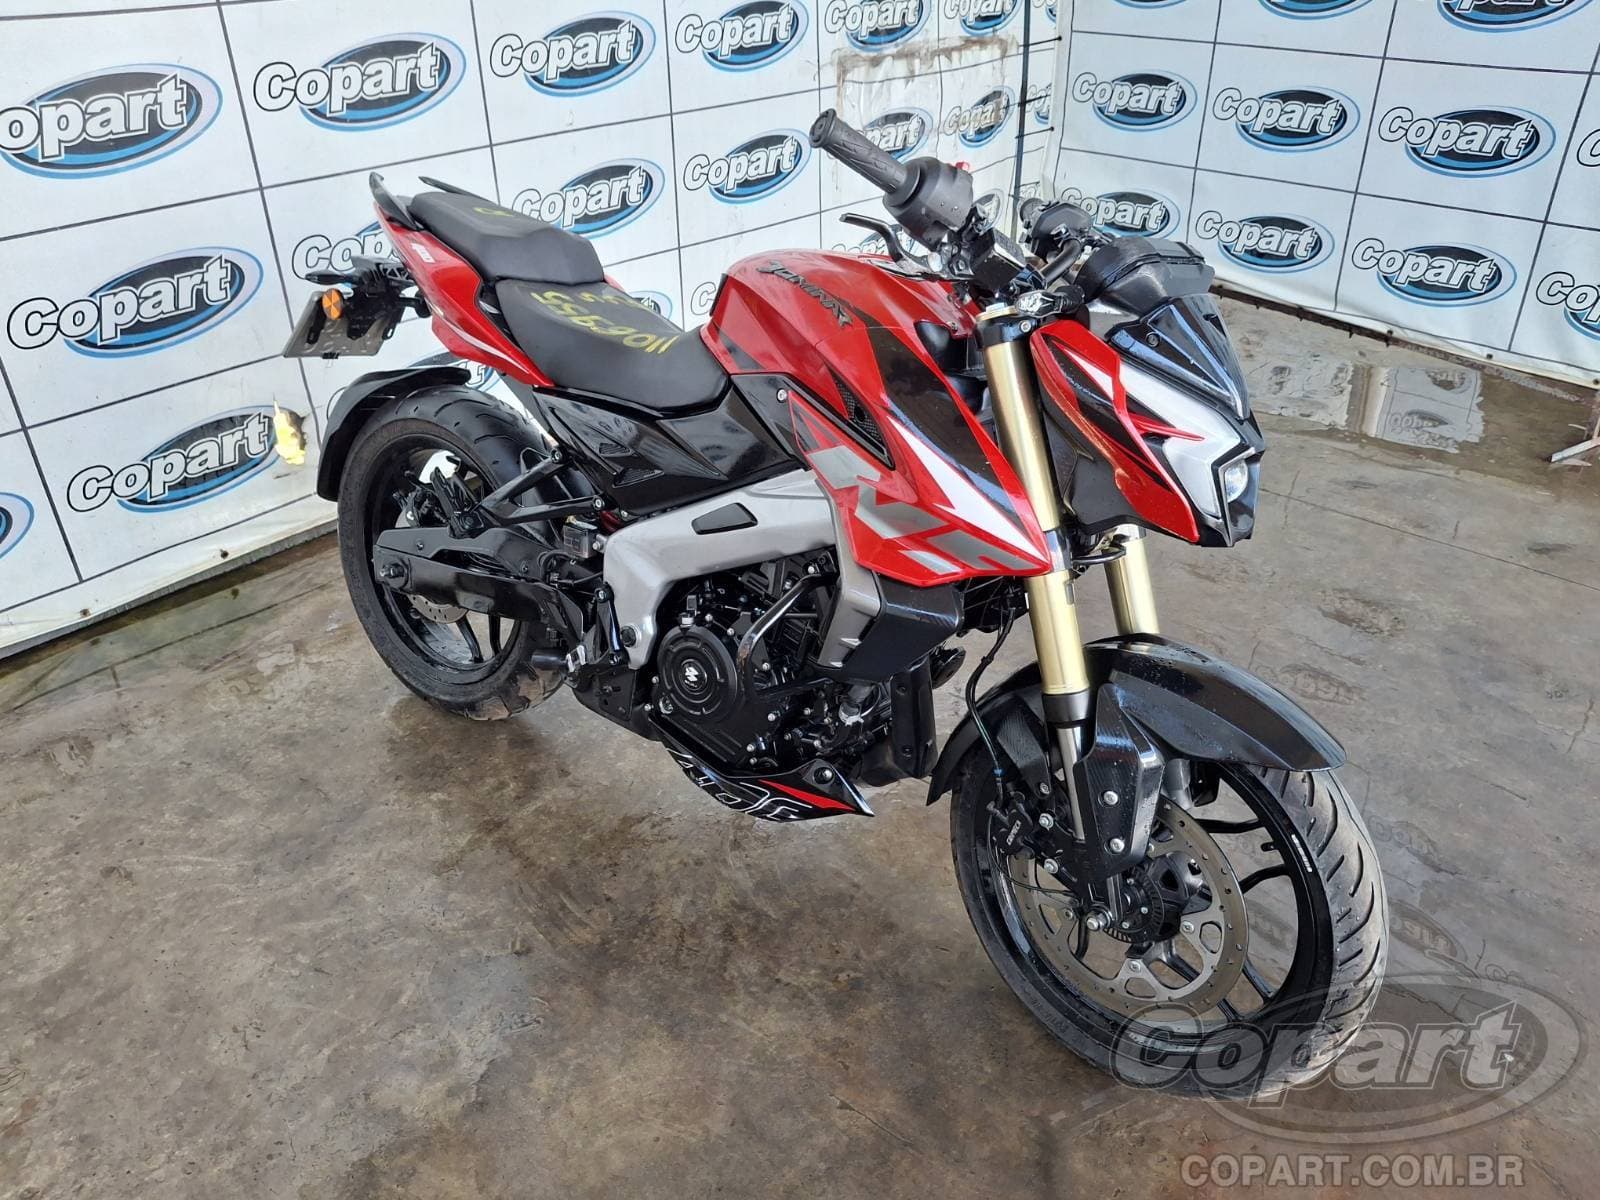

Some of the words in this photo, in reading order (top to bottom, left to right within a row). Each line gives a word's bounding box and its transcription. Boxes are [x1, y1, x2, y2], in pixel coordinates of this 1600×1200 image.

[675, 2, 797, 59] Copart
[825, 0, 918, 39] Copart
[490, 20, 638, 82] Copart
[253, 42, 441, 117] Copart
[1072, 72, 1184, 115] Copart
[0, 74, 188, 162] opart
[943, 91, 1009, 138] Copa
[1213, 88, 1344, 134] Copart
[1378, 107, 1536, 158] Copart
[683, 136, 800, 193] Copart
[512, 166, 648, 229] Copart
[1061, 187, 1169, 231] Copart
[1195, 210, 1320, 259] Copart
[1351, 238, 1498, 293] Copart
[7, 254, 232, 349] Copart
[67, 411, 271, 512] Copart
